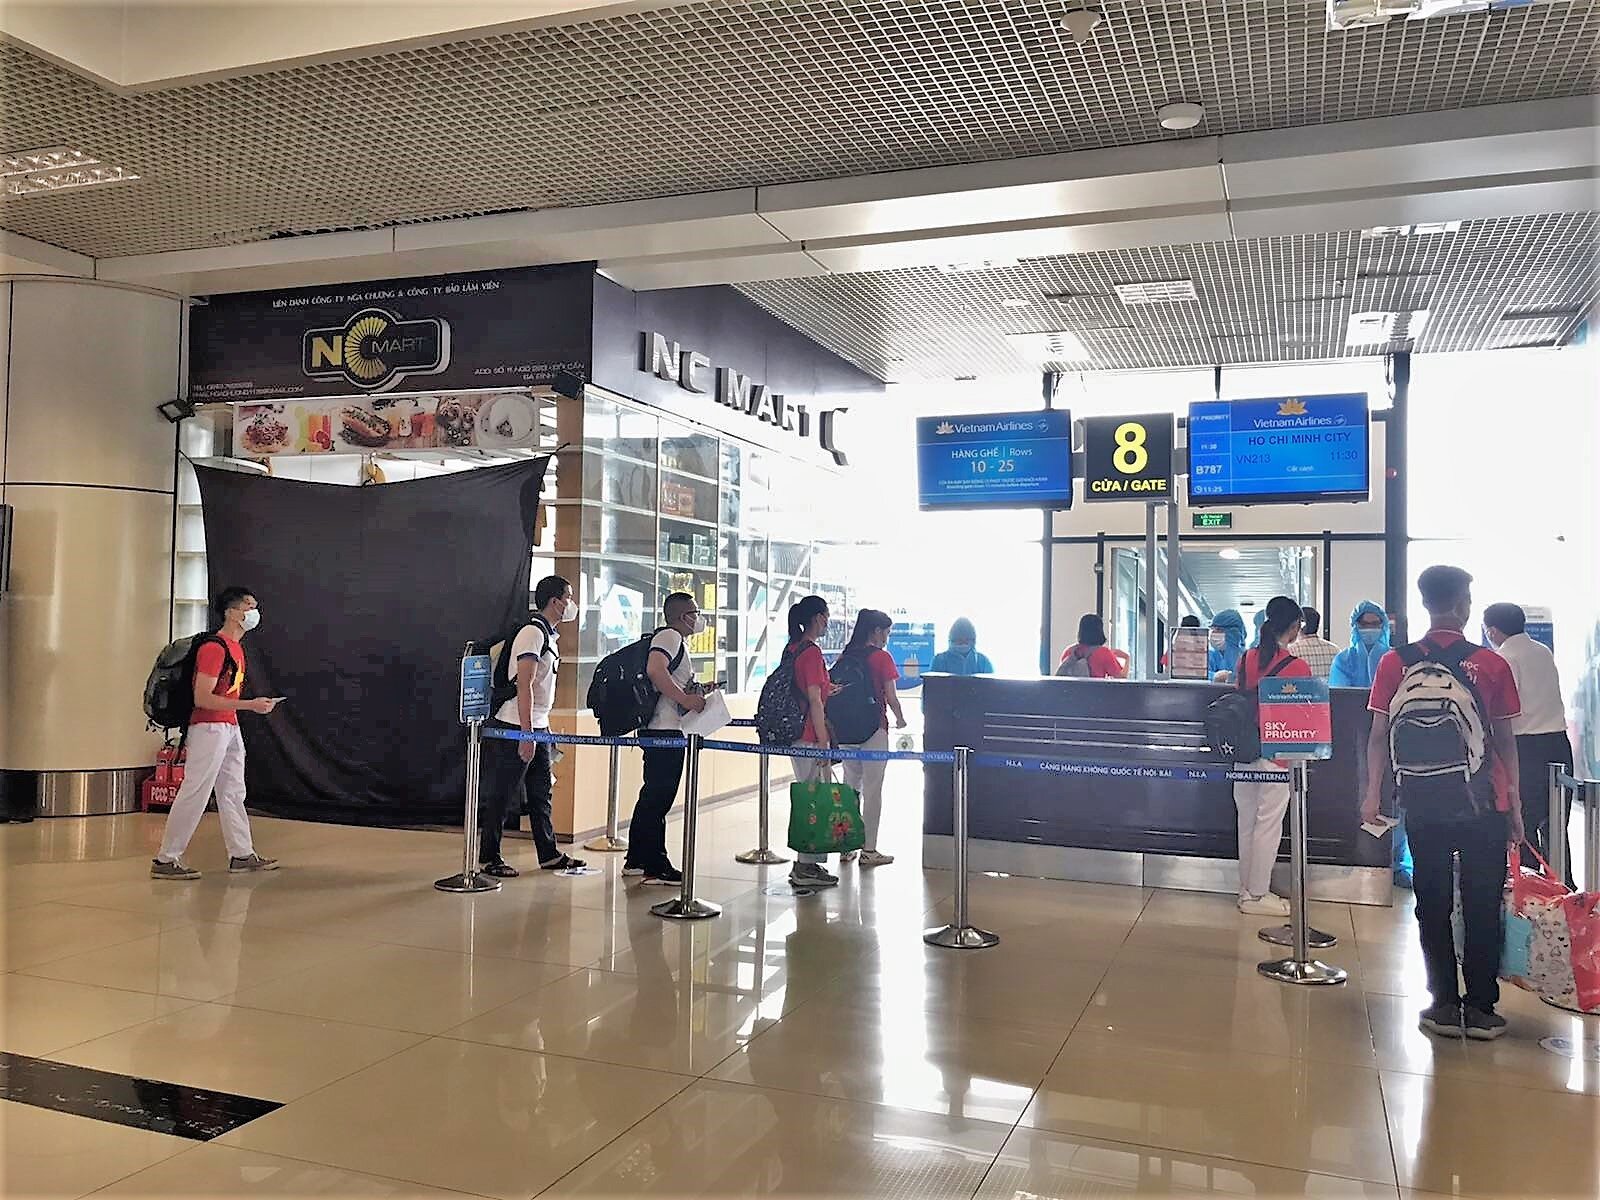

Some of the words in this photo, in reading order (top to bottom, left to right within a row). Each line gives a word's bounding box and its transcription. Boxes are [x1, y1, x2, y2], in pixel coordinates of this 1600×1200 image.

[372, 336, 424, 353] MART
[640, 331, 711, 394] NC
[1248, 436, 1265, 446] HO
[1268, 435, 1288, 445] CHI
[1292, 434, 1321, 444] MINH
[1324, 432, 1351, 442] CITY
[951, 449, 978, 459] HÀNG
[1009, 447, 1033, 457] Rows
[1113, 422, 1148, 474] 8
[1235, 454, 1271, 464] VN213
[1329, 450, 1358, 461] 11:30
[971, 461, 986, 473] 10
[998, 459, 1014, 472] 25
[1195, 464, 1223, 475] B787
[1091, 478, 1122, 492] CỬA
[1130, 479, 1167, 492] GATE
[1264, 721, 1287, 731] SKY
[1264, 730, 1316, 739] PRIORITY
[150, 786, 169, 802] PCCC
